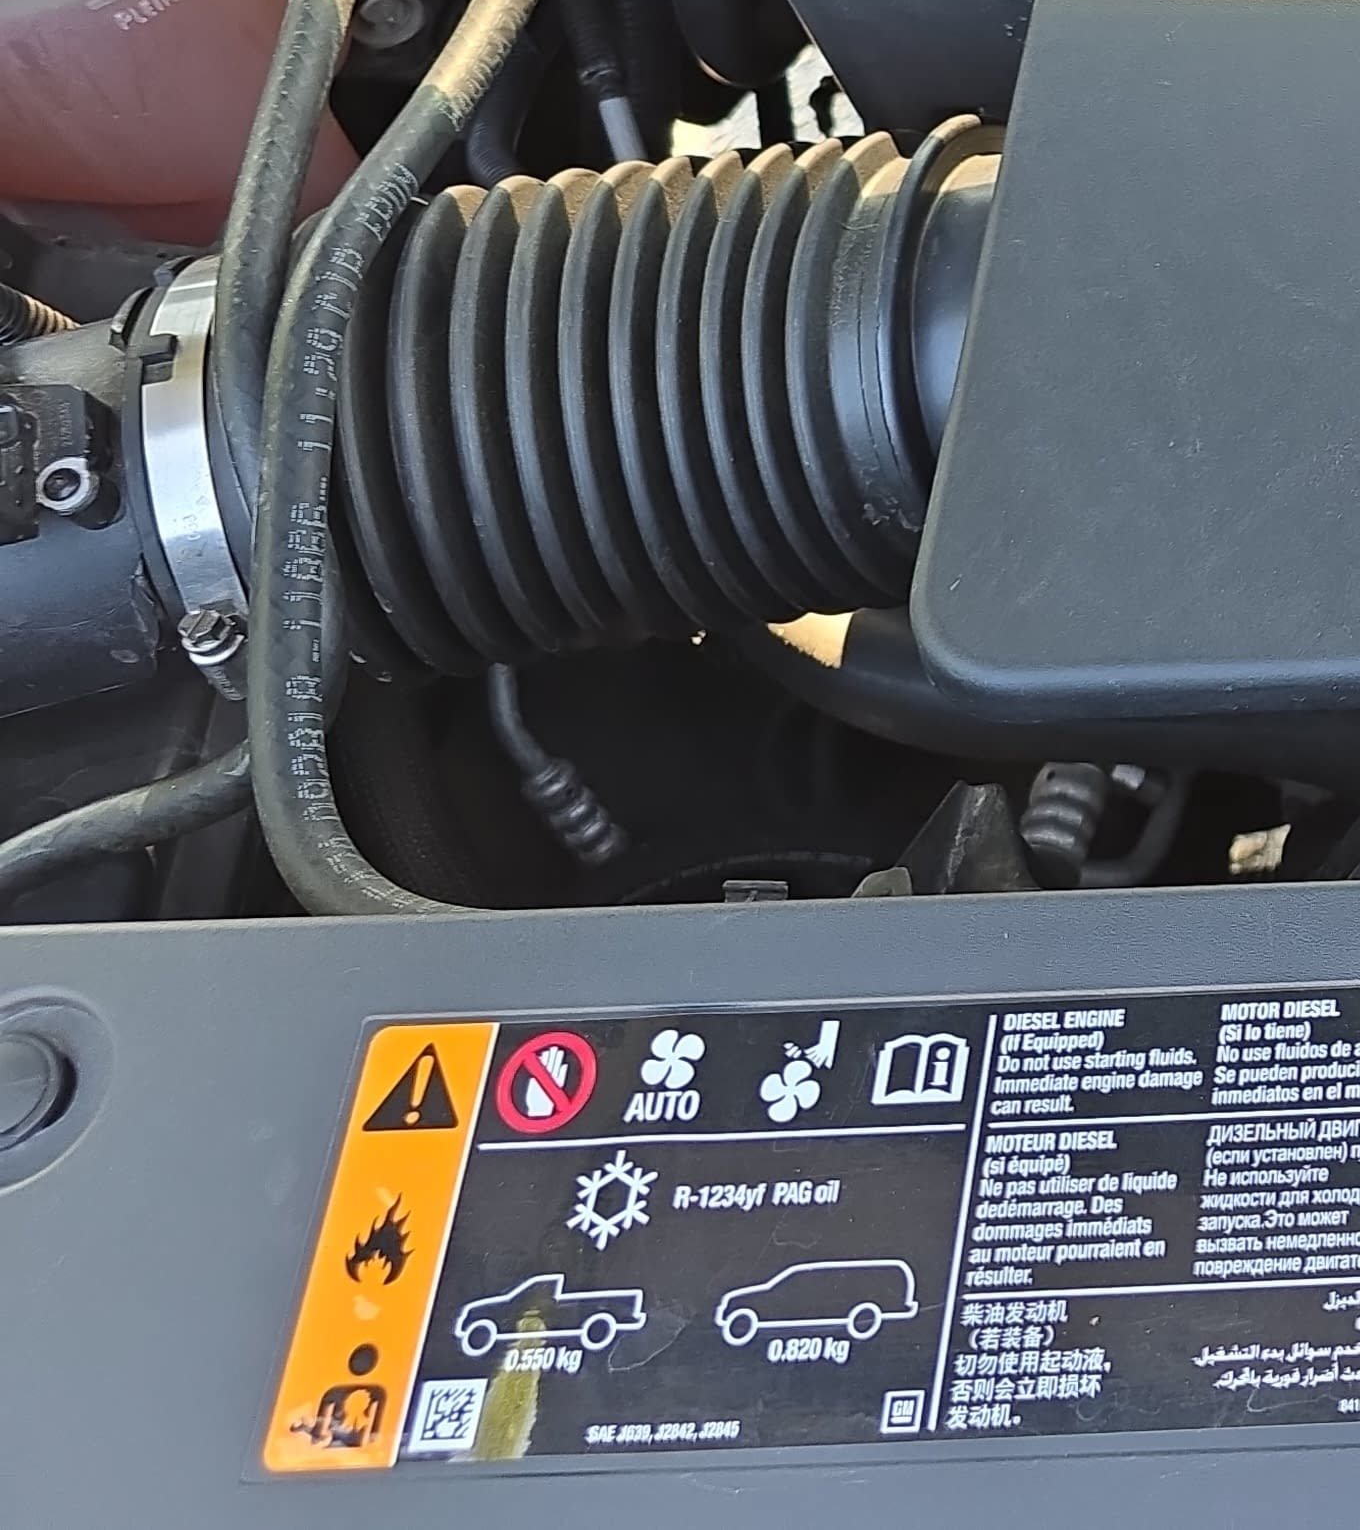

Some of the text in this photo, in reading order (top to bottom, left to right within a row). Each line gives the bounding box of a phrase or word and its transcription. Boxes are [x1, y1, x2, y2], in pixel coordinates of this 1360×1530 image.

[1003, 1009, 1126, 1031] DIESEL ENGINE
[1221, 999, 1341, 1021] MOTOR DIESEL
[1001, 1031, 1105, 1054] (If Equipped)
[1219, 1020, 1311, 1044] (Si lo tiene)
[998, 1047, 1197, 1072] Do not use starting fluids.
[1216, 1045, 1239, 1063] No
[1242, 1046, 1271, 1060] use
[1275, 1043, 1328, 1059] fluidos
[1330, 1041, 1351, 1057] de
[994, 1070, 1203, 1094] Immediate engine damage
[1214, 1066, 1236, 1084] Se
[1238, 1064, 1298, 1085] pueden
[990, 1094, 1075, 1115] can result.
[1211, 1085, 1299, 1105] inmediatos
[1302, 1087, 1322, 1101] en
[1326, 1083, 1342, 1099] el
[624, 1090, 700, 1122] AUTO
[985, 1131, 1118, 1154] MOTEUR DIESEL
[1206, 1118, 1316, 1146] ДИЗЕЛЬНЫЙ
[983, 1154, 1071, 1178] (si équipé)
[1205, 1146, 1250, 1168] (если
[1252, 1141, 1348, 1167] установлен)
[979, 1171, 1178, 1199] Ne pas utiliser de liquide
[1203, 1165, 1329, 1187] Не используйте
[672, 1179, 841, 1211] R-1234yf PAG oil
[1090, 1196, 1123, 1214] Des
[1201, 1191, 1276, 1210] жидкости
[1278, 1191, 1309, 1207] для
[972, 1217, 1152, 1242] dommages immédiats
[1298, 1210, 1350, 1226] может
[968, 1238, 1166, 1265] au moteur pourraient en
[1195, 1237, 1263, 1253] вызвать
[965, 1266, 1033, 1286] résulter.
[1193, 1255, 1301, 1278] повреждение
[960, 1300, 1069, 1326] 柴油发动机
[504, 1346, 584, 1375] 0.550 kg
[767, 1337, 851, 1364] 0.820 kg
[951, 1374, 1102, 1403] 否则会立即损坏
[891, 1401, 915, 1416] GM
[585, 1424, 617, 1444] SAE
